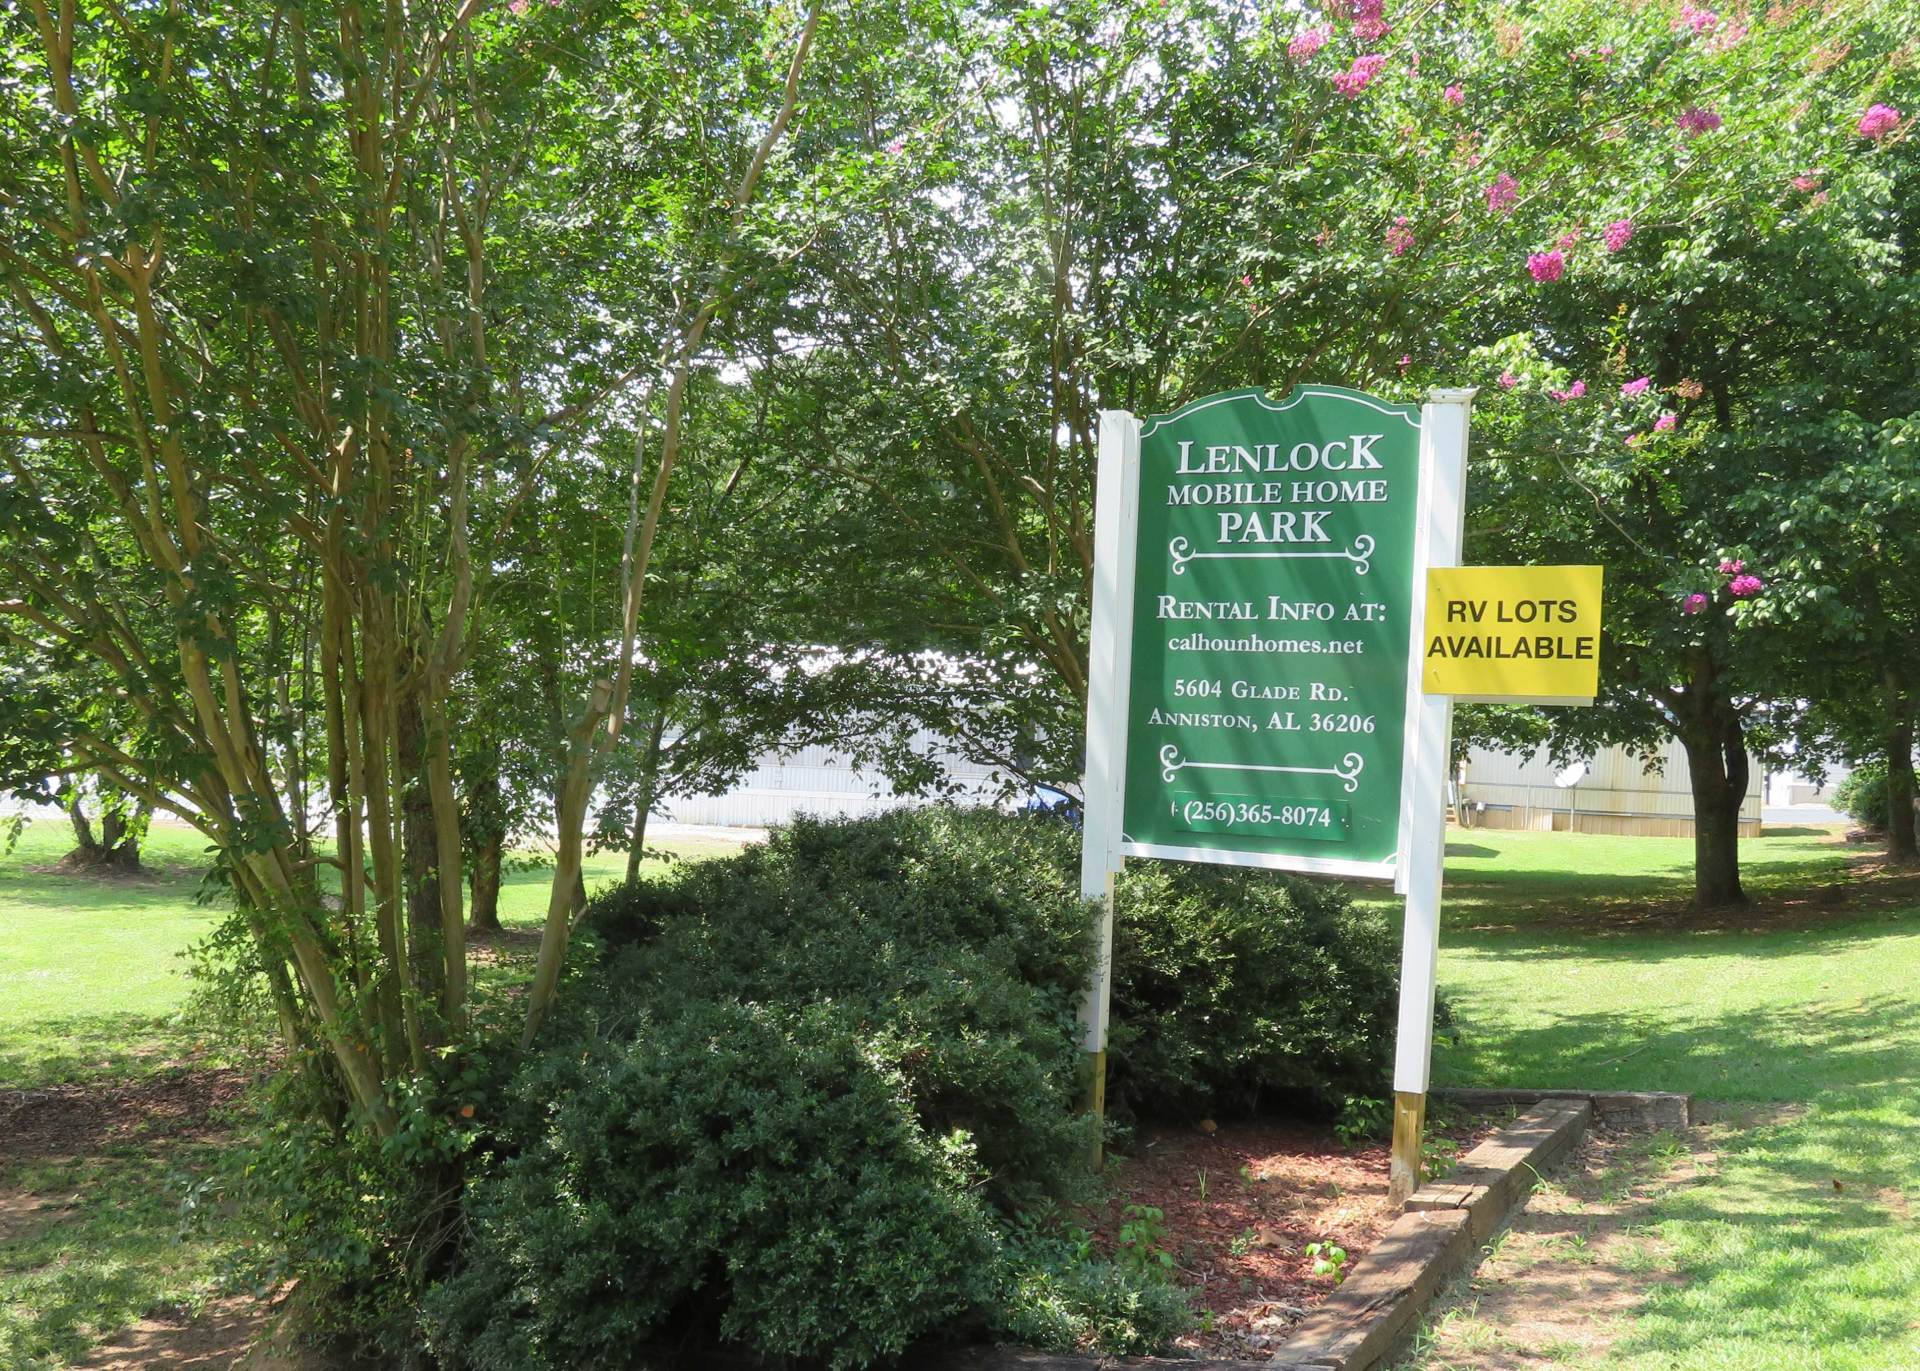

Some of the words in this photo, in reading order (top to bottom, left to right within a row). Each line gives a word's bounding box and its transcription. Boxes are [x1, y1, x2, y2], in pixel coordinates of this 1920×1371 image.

[1176, 434, 1384, 474] LENLOCK
[1166, 482, 1282, 506] MOBILE
[1290, 480, 1388, 503] HOME
[1217, 510, 1332, 544] PARK
[1156, 595, 1258, 620] RENTAL
[1267, 596, 1335, 621] INFO
[1342, 603, 1386, 622] AT:
[1447, 600, 1487, 623] RV
[1497, 600, 1577, 623] LOTS
[1168, 633, 1364, 654] calhounhomes.net
[1427, 636, 1594, 659] AVAILABLE
[1174, 679, 1222, 698] 5604
[1231, 680, 1300, 700] GLADE
[1309, 683, 1348, 702] RD.
[1148, 708, 1258, 732] ANNISTON,
[1266, 712, 1300, 731] AL
[1308, 714, 1376, 733] 36206
[1184, 800, 1331, 827] (256)365-8074
